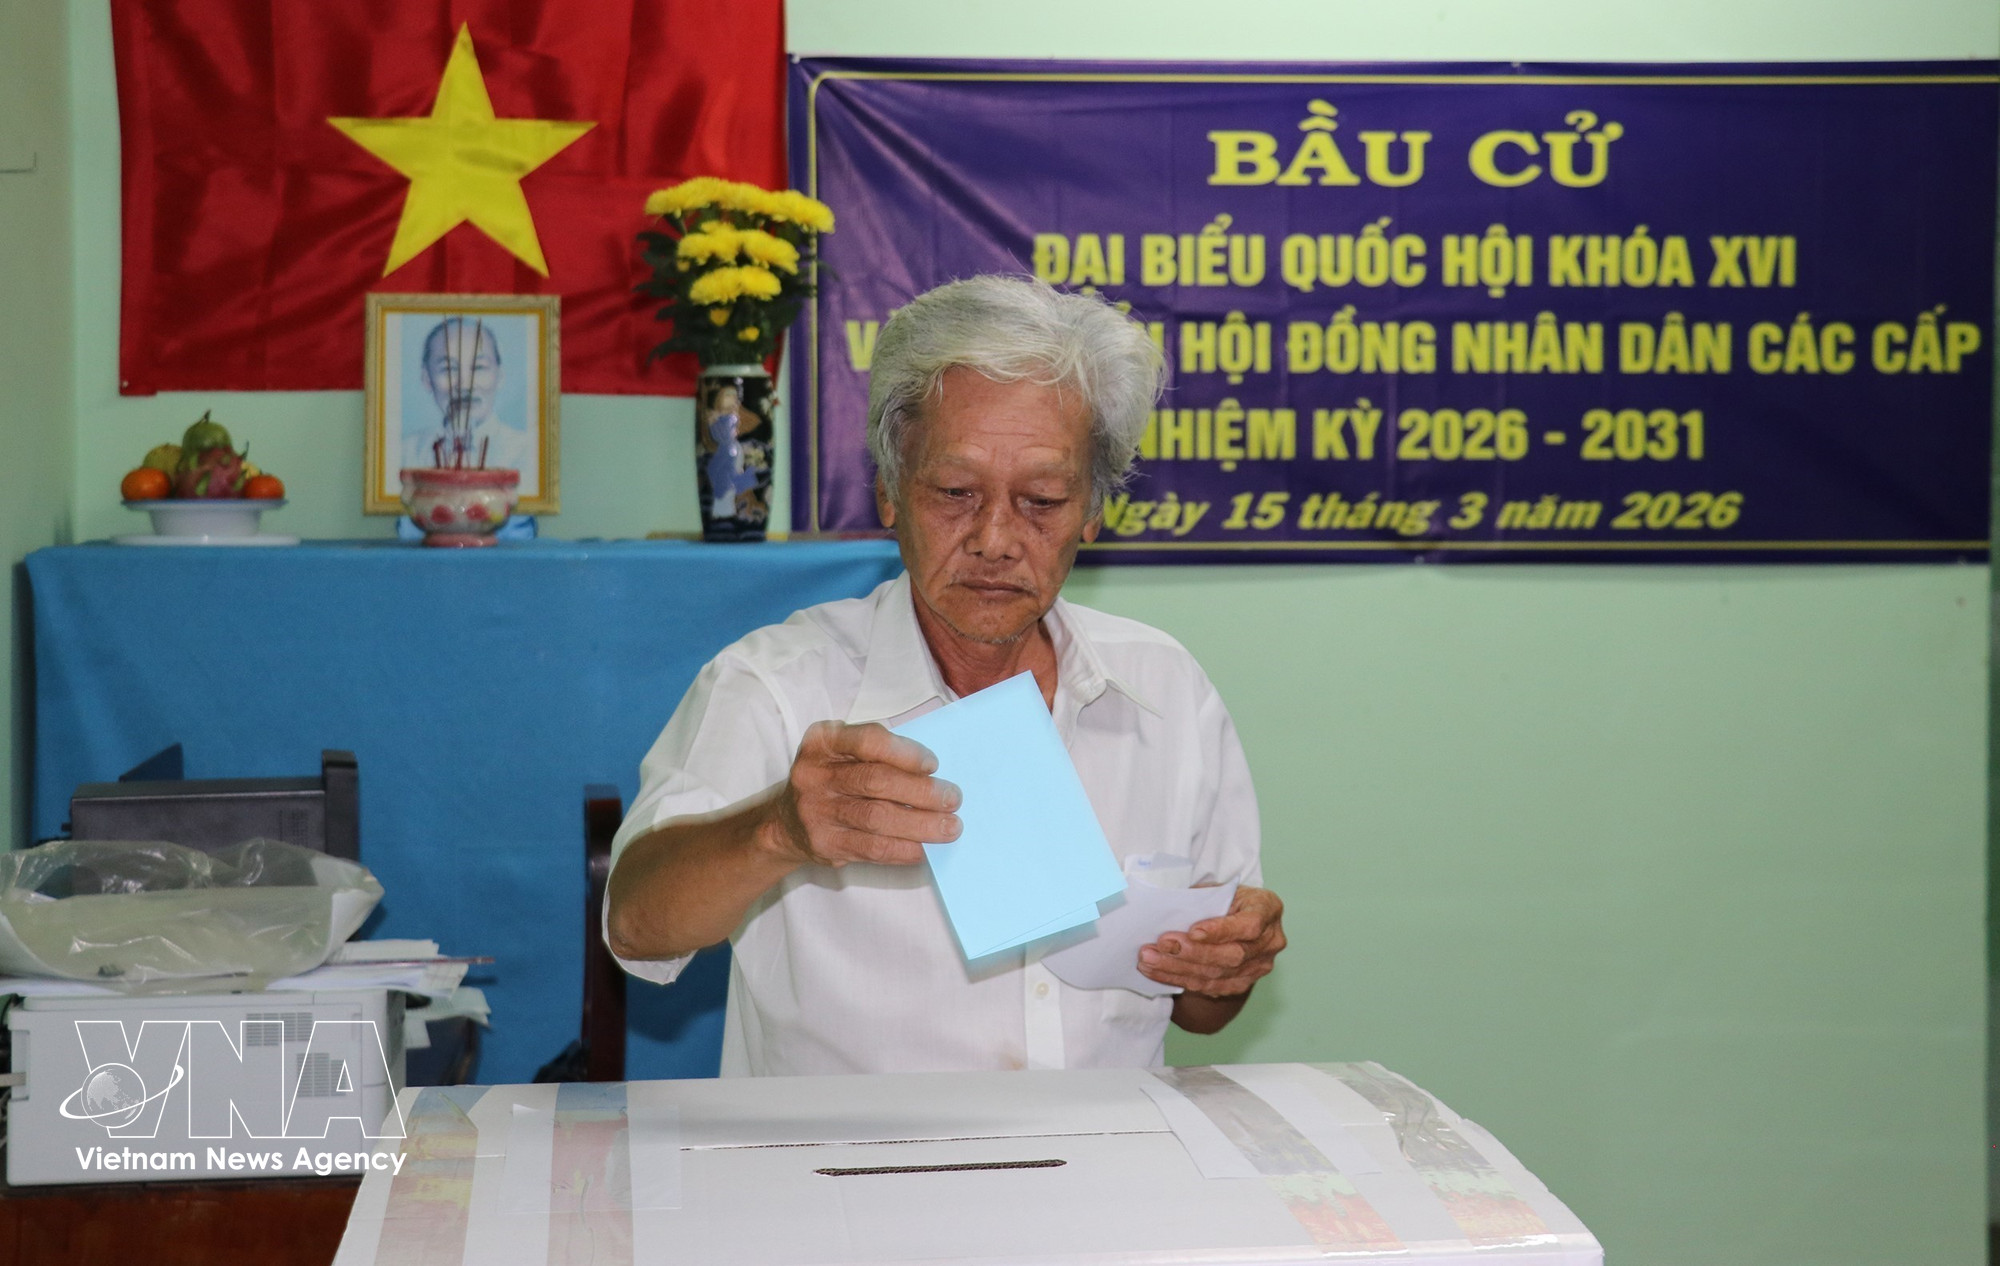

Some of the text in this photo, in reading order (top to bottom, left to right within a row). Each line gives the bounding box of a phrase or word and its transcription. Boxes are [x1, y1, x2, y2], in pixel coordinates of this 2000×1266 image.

[1207, 99, 1623, 187] BẦU CỬ
[1032, 214, 1797, 297] ĐẠI BIỂU QUỐC HỘI KHÓA XVI
[1180, 311, 1271, 383] HỘI
[1285, 305, 1437, 373] ĐỒNG
[1451, 311, 1604, 373] NHÂN
[1618, 312, 1732, 374] DÂN
[1747, 312, 1855, 374] CÁC
[1872, 304, 1982, 374] CẤP
[1312, 399, 1382, 459] KỲ
[1396, 409, 1529, 460] 2026
[1543, 430, 1566, 445] -
[1580, 409, 1704, 460] 2031
[1222, 492, 1290, 529] 15
[1298, 491, 1440, 536] tháng
[1449, 491, 1488, 529] 3
[1496, 494, 1602, 529] năm
[1611, 491, 1744, 529] 2026
